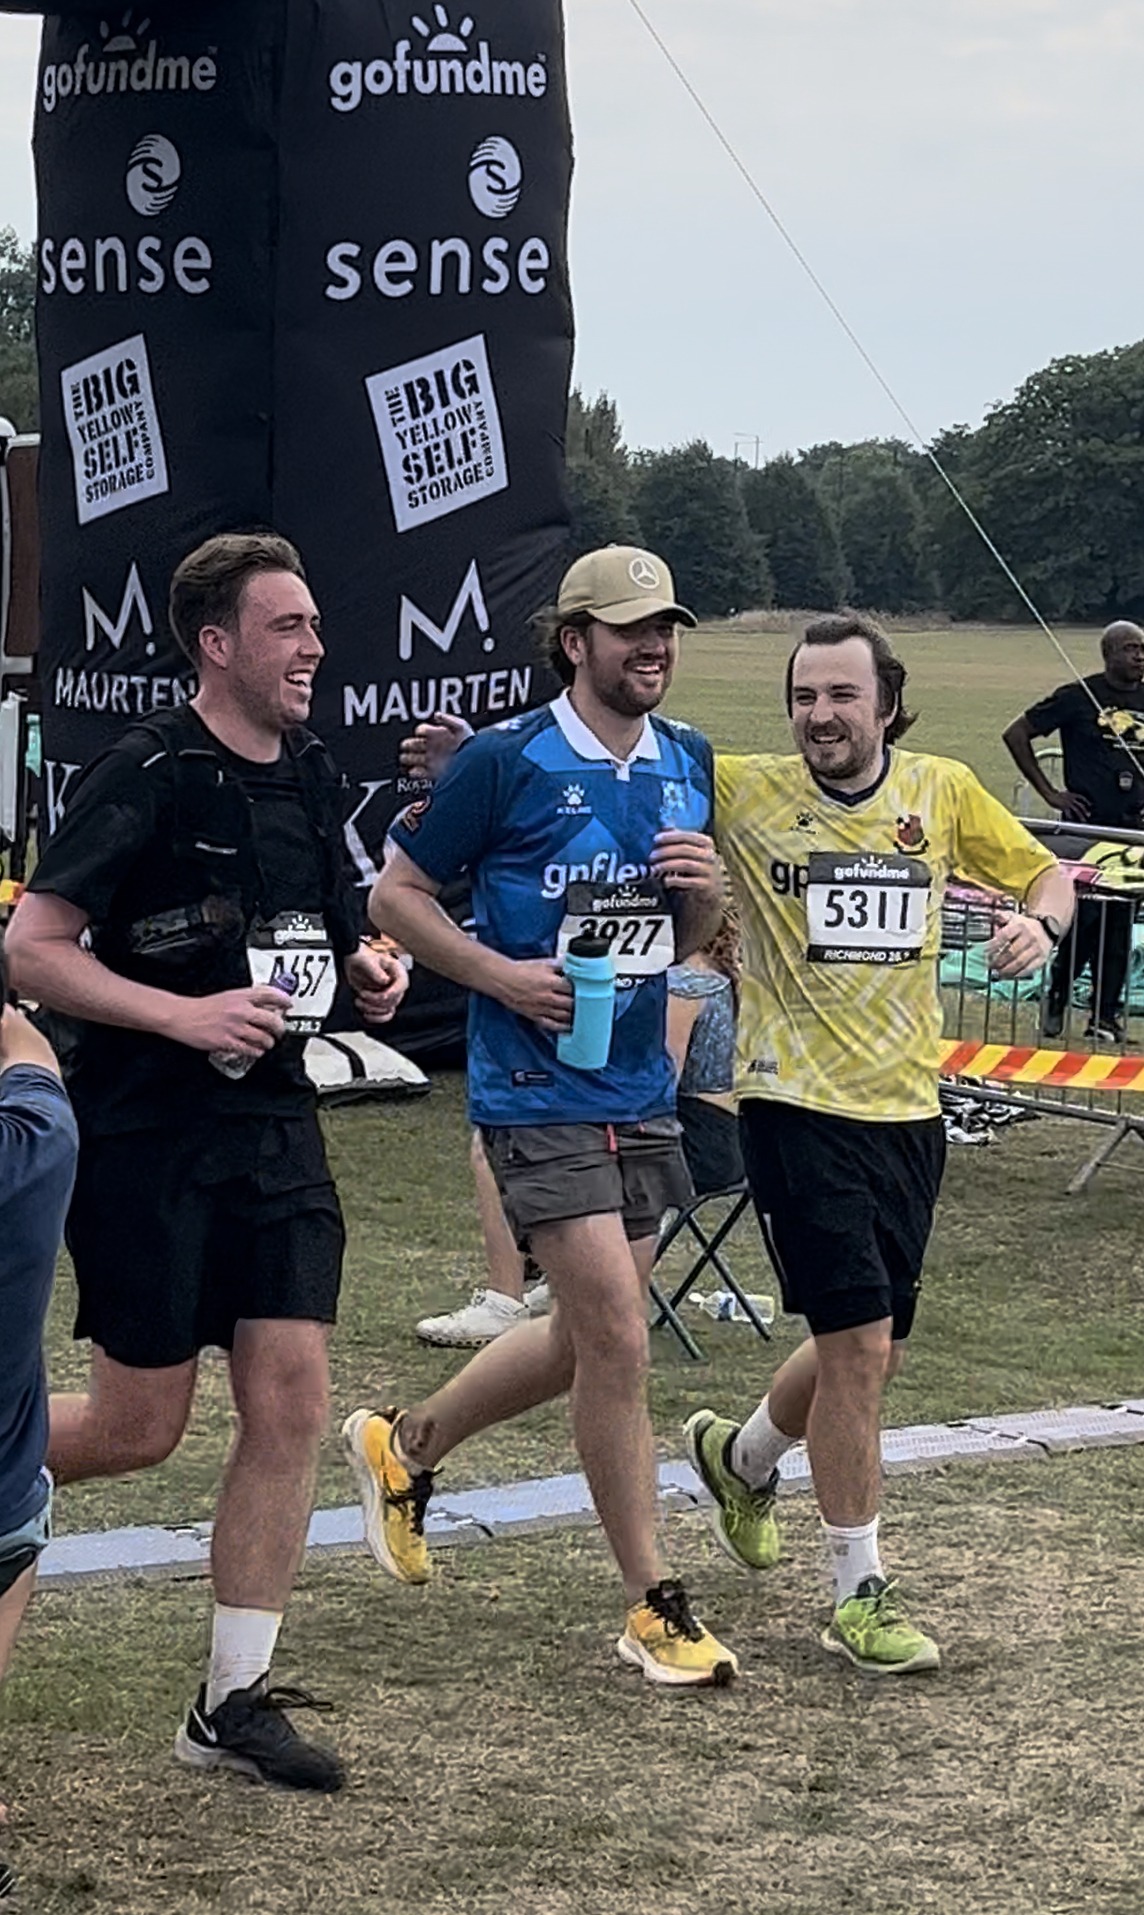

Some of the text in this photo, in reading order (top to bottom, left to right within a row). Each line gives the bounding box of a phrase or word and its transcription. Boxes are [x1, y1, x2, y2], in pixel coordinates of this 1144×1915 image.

[42, 39, 217, 113] gofundme
[329, 39, 547, 113] gofundme
[42, 237, 212, 295] sense
[326, 237, 549, 300] sense
[70, 381, 84, 421] THE
[82, 358, 141, 416] BIG
[384, 386, 406, 427] THE
[403, 359, 480, 420] BIG
[77, 404, 135, 444] YELLOW
[395, 404, 473, 450] YELLOW
[84, 427, 139, 479] SELF
[402, 427, 477, 485] SELF
[85, 462, 145, 503] STORAGE
[408, 462, 485, 509] STORAGE
[55, 667, 196, 714] MAURTEN
[343, 666, 532, 727] MAURTEN
[834, 863, 909, 880] gofundme
[824, 889, 909, 930] 5311
